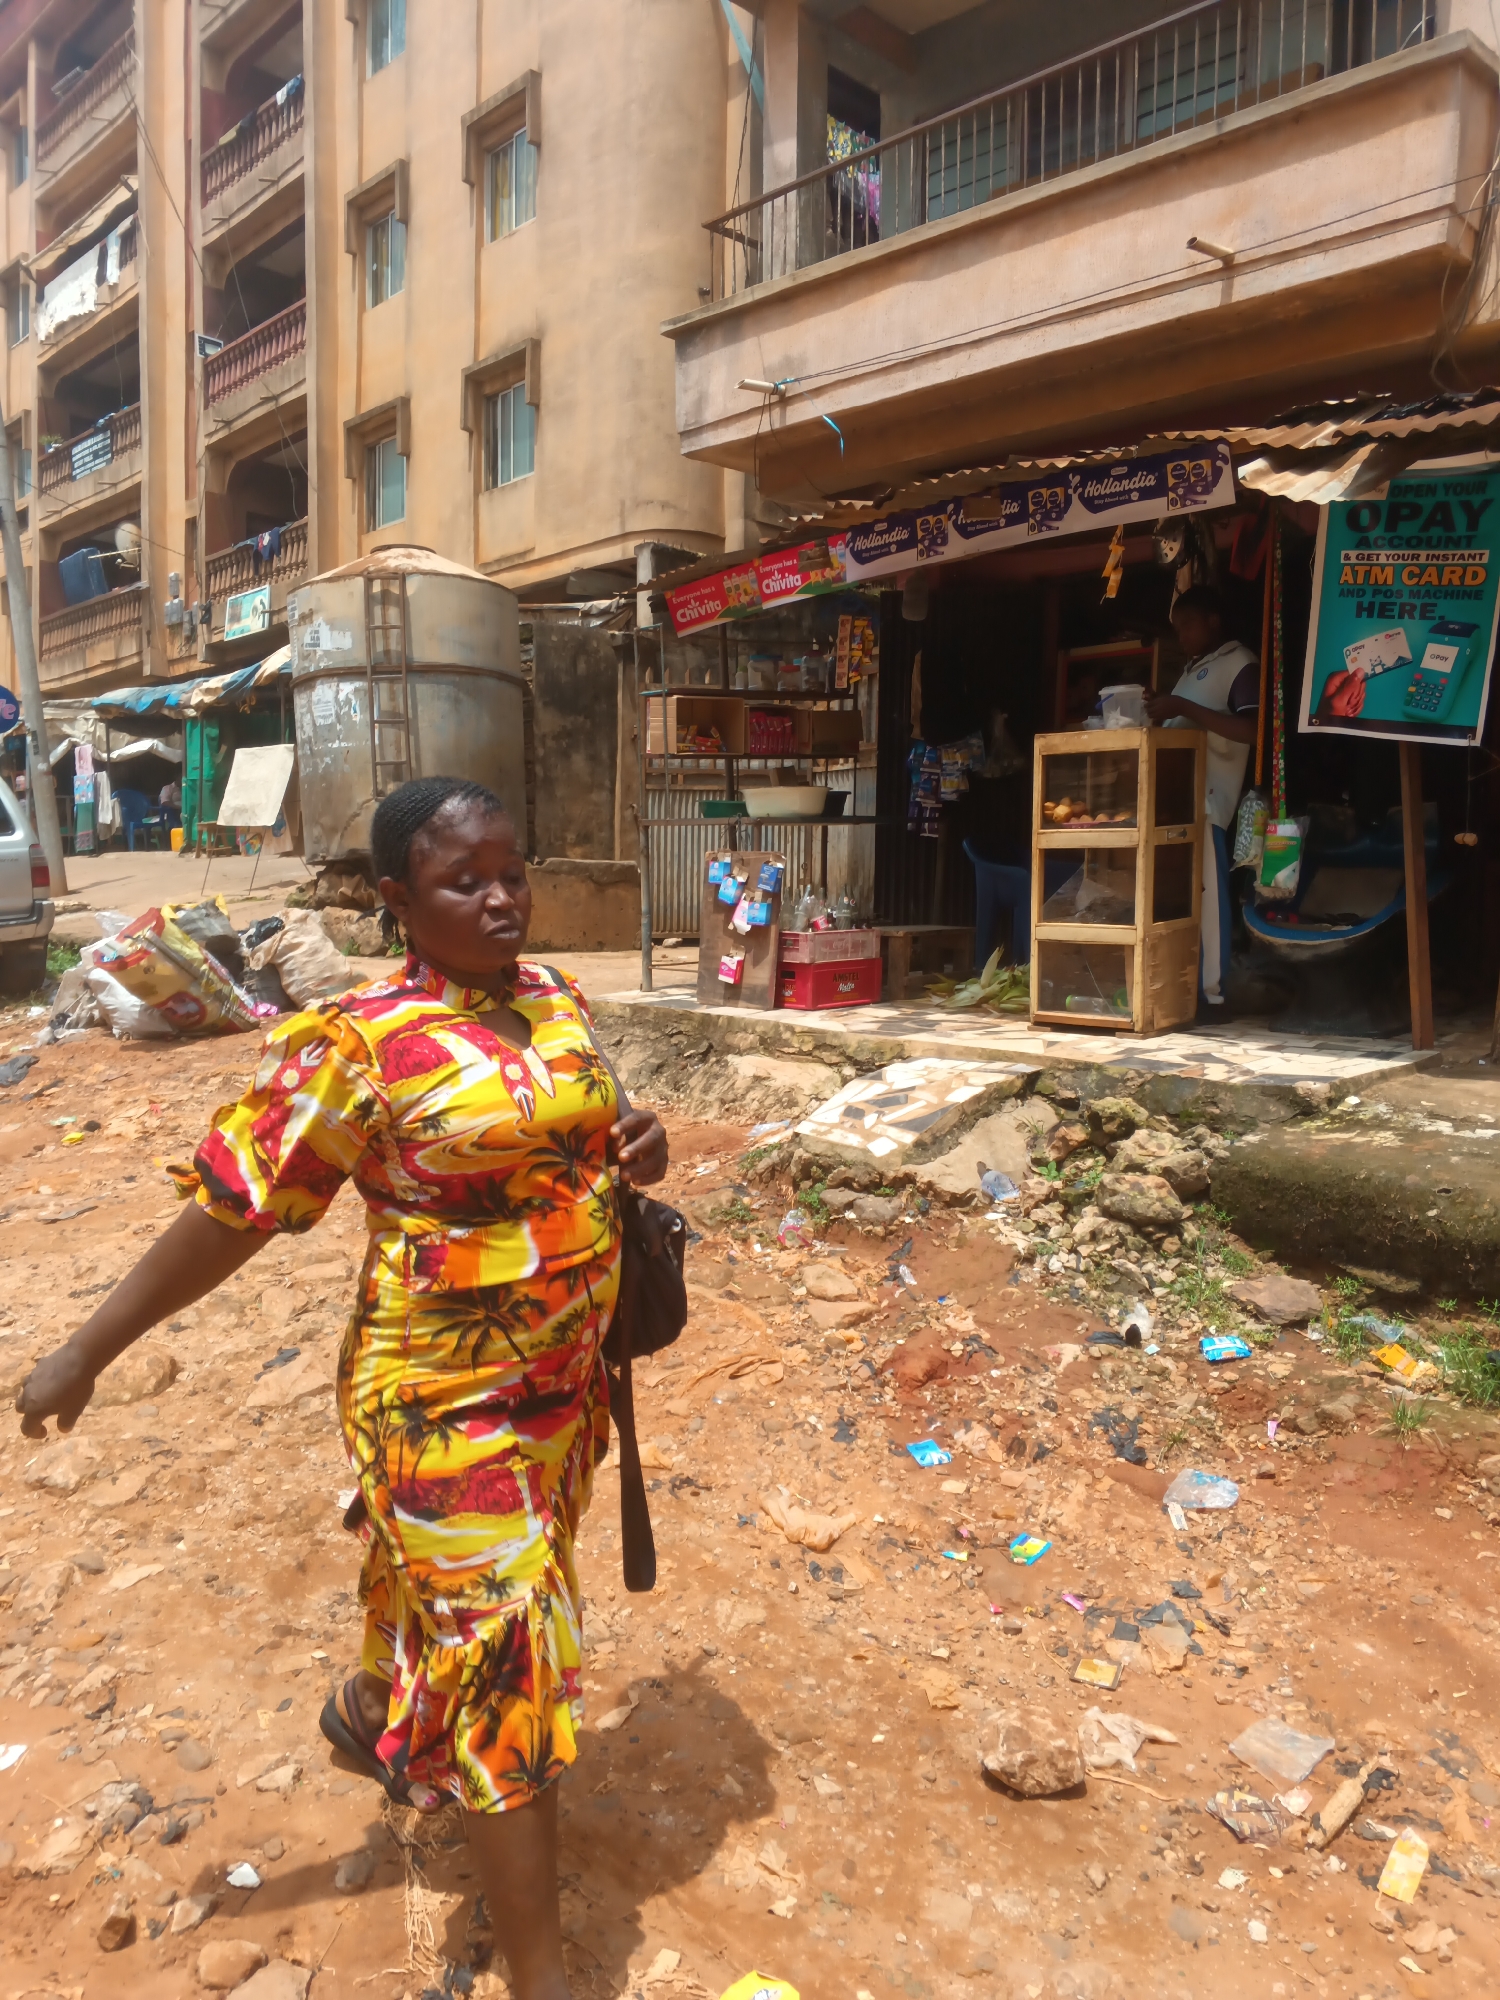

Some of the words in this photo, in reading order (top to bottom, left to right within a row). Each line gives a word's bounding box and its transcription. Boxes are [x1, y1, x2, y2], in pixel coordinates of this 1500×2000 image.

[1084, 471, 1157, 498] Hollandia
[1389, 483, 1438, 498] OPEN
[1442, 480, 1488, 496] YOUR
[1345, 499, 1494, 533] OPAY
[854, 526, 910, 551] Hollandia
[1354, 535, 1477, 549] ACCOUNT
[759, 562, 783, 574] Everyone
[783, 559, 793, 568] has
[1343, 553, 1351, 561] &
[1355, 553, 1381, 561] GET
[1385, 553, 1421, 562] YOUR
[1425, 552, 1486, 562] INSTANT
[761, 572, 802, 594] Chivita
[1339, 565, 1395, 585] ATM
[1401, 565, 1487, 586] CARD
[672, 591, 701, 605] Everyone
[700, 587, 712, 596] has
[1338, 588, 1367, 598] AND
[1371, 588, 1404, 599] POS
[1408, 589, 1484, 600] MACHINE
[676, 599, 722, 623] Chivita
[1355, 601, 1446, 621] HERE.
